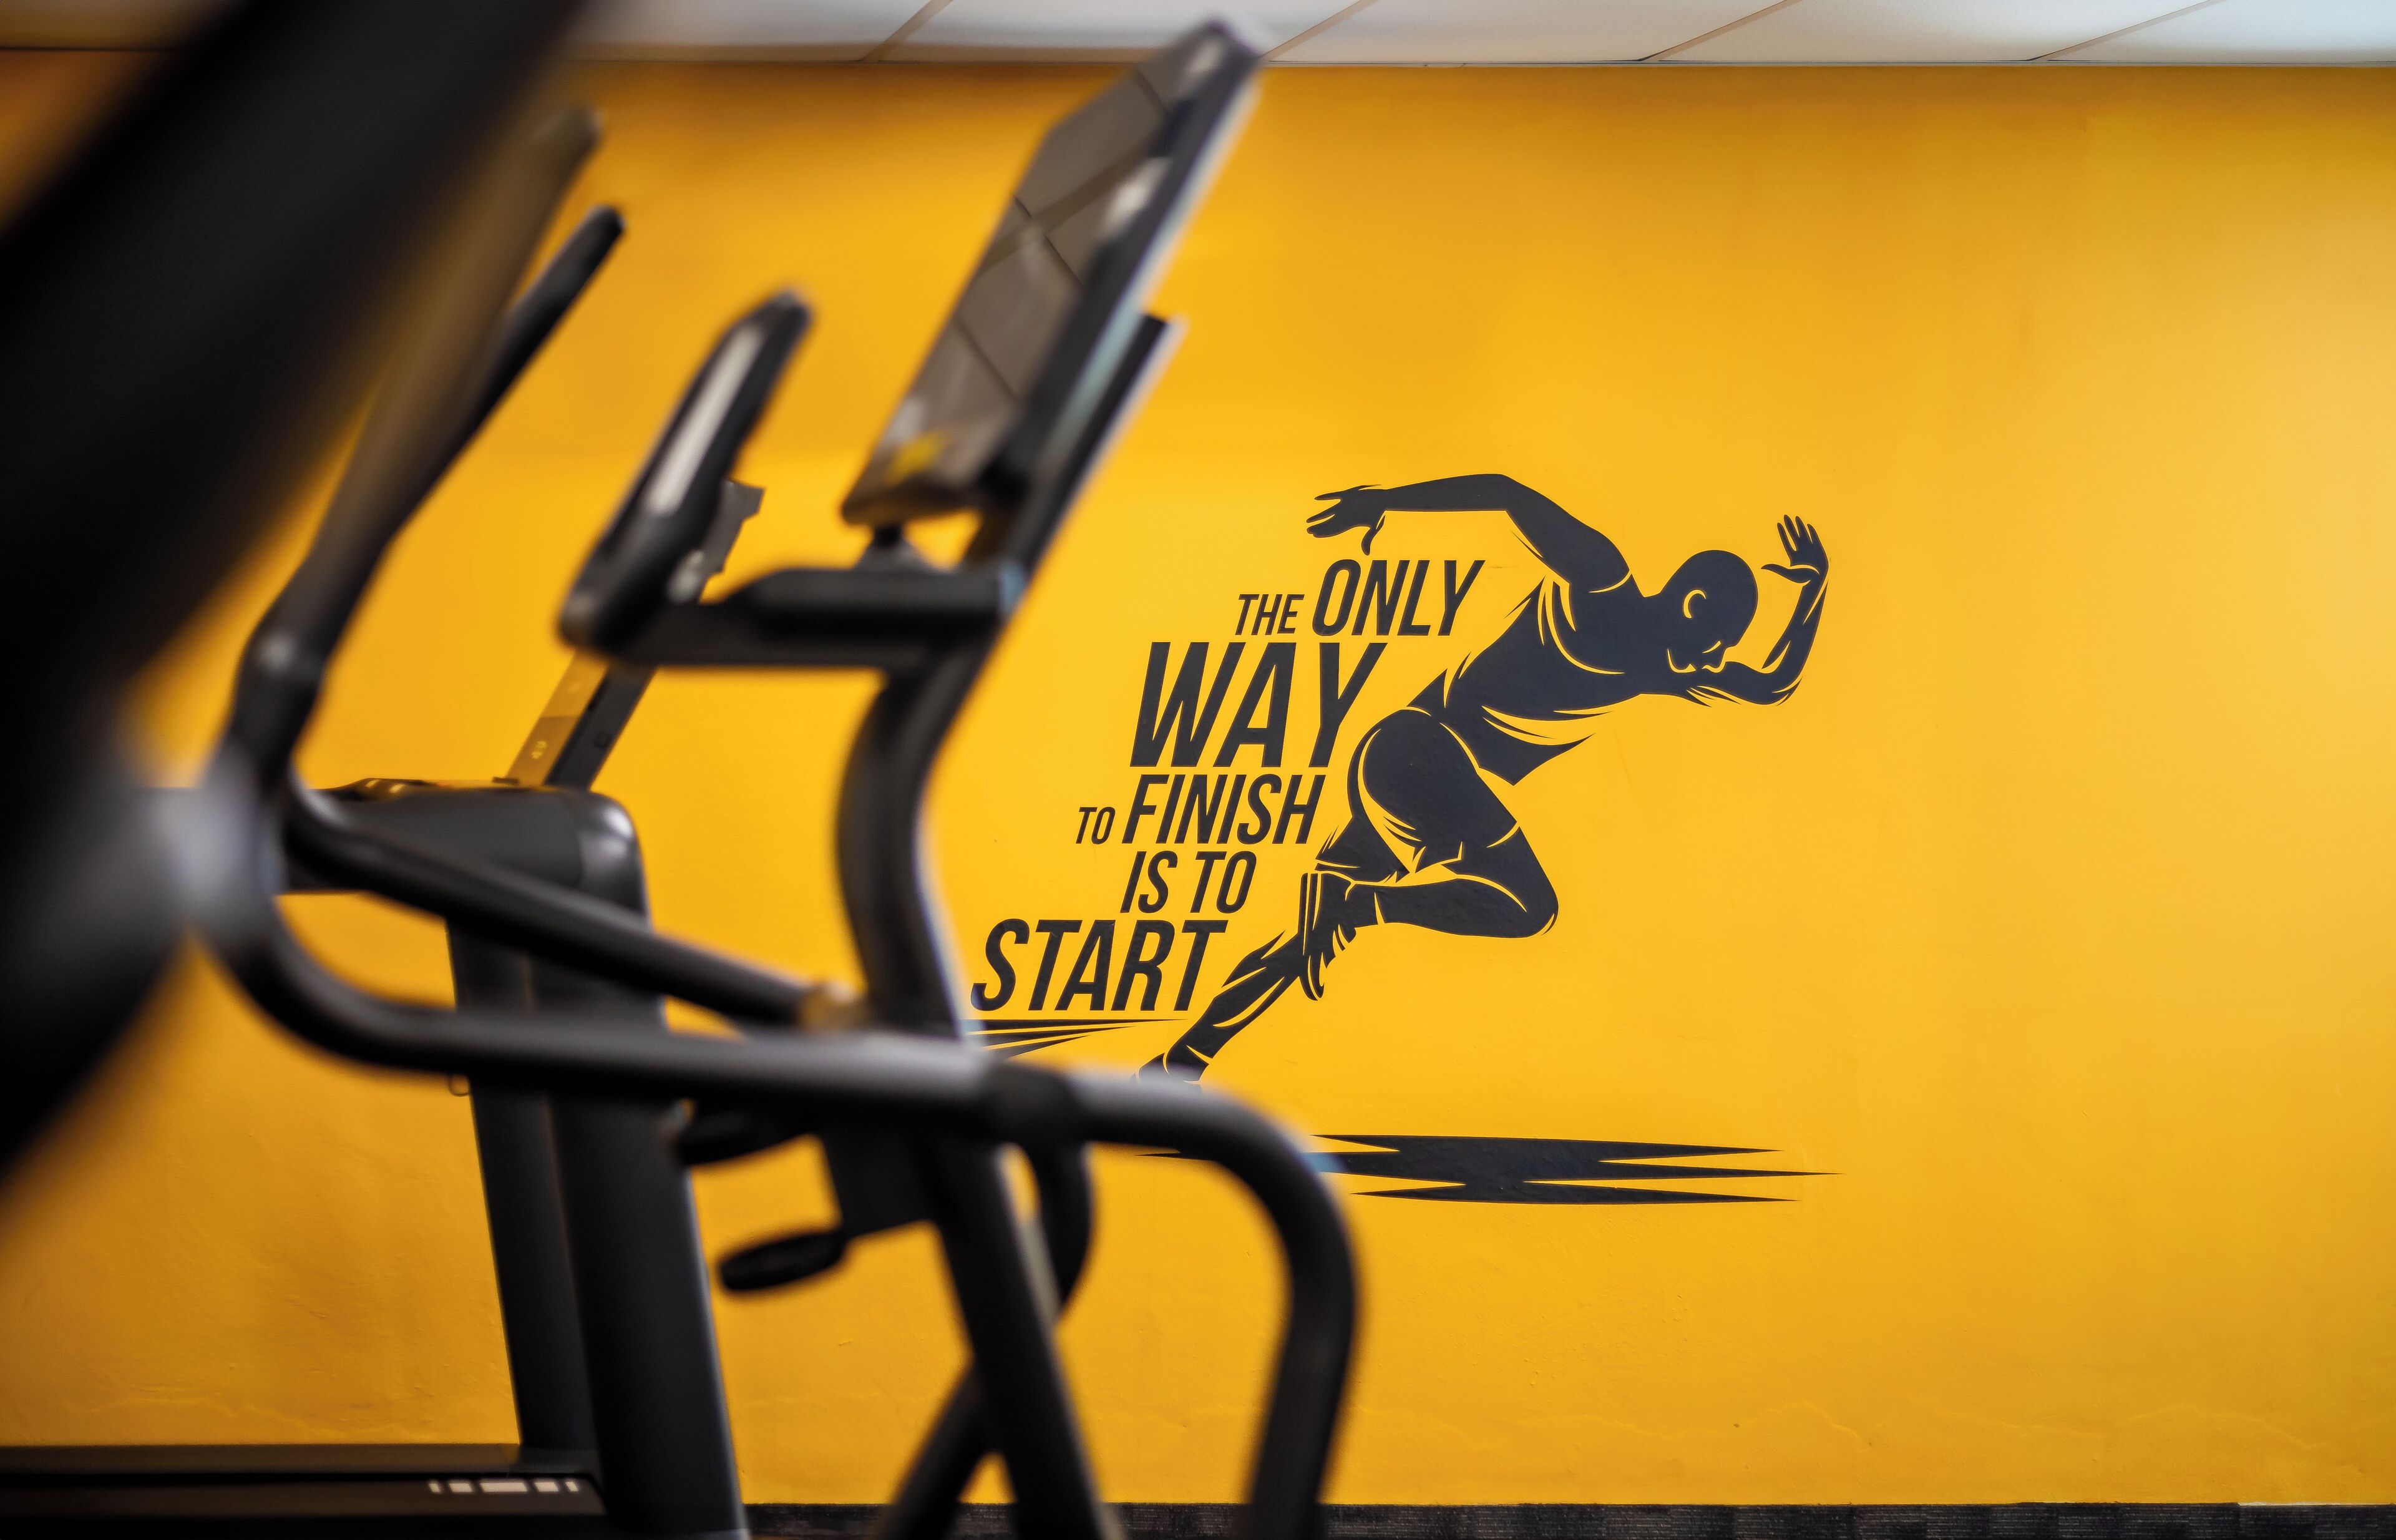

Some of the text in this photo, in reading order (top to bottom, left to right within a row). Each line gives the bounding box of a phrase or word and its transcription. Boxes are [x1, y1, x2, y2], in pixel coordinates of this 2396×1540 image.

[1235, 559, 1486, 636] THE ONLY
[1129, 641, 1388, 768] WAY
[1076, 773, 1327, 845] TO FINISH
[1120, 850, 1257, 914] IS TO
[970, 918, 1229, 1011] START
